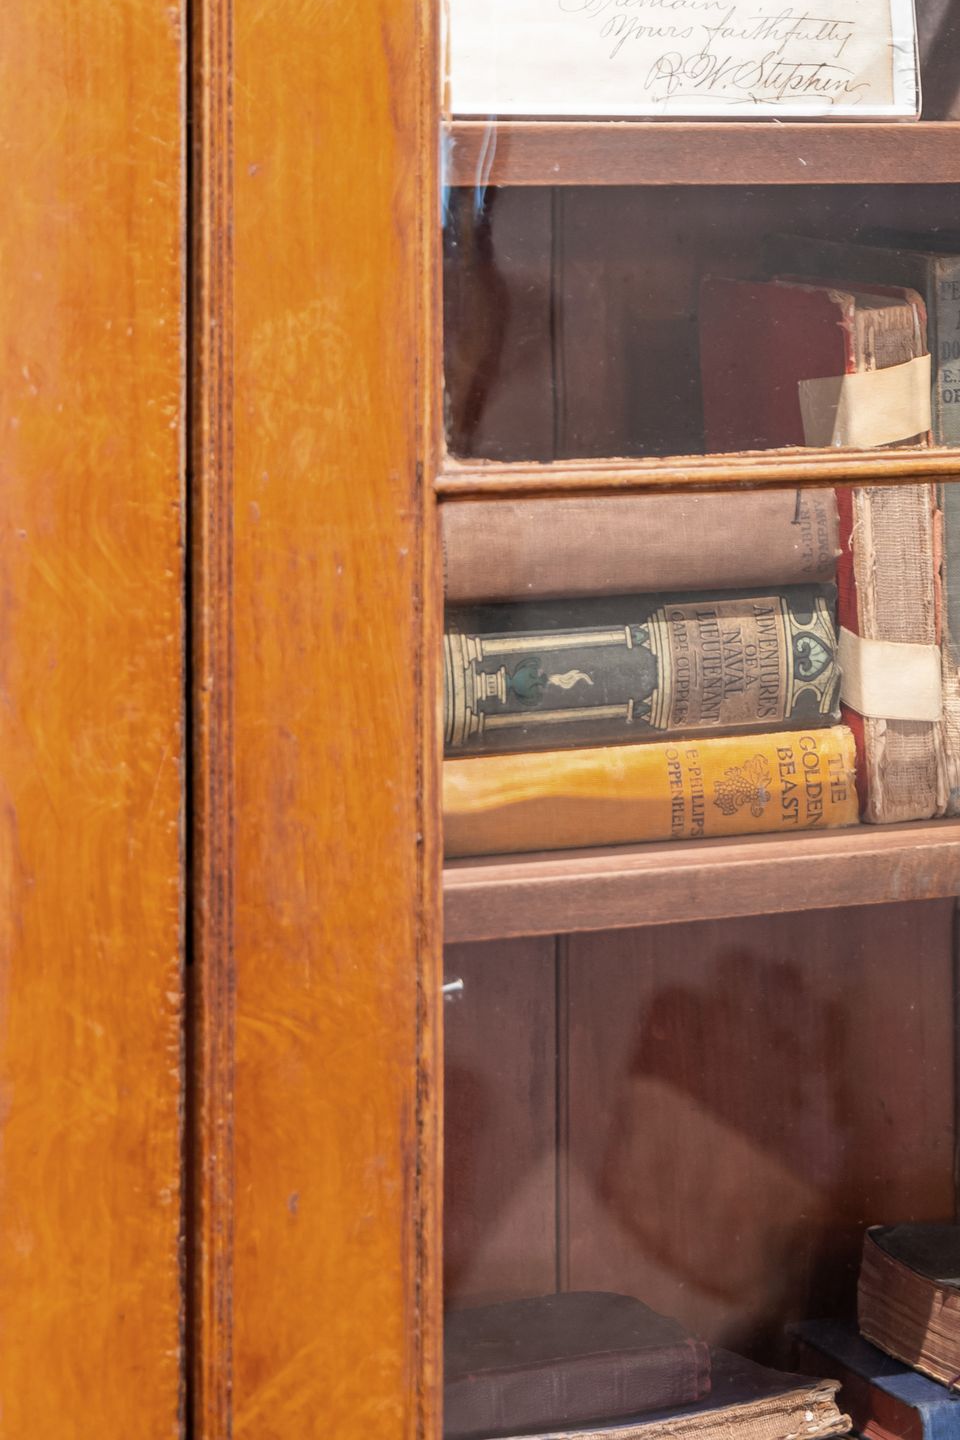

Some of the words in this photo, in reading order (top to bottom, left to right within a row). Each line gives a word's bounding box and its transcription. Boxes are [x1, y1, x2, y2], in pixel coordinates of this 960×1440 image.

[674, 656, 691, 726] CUPPLES
[695, 610, 721, 725] LIEUTENANT
[722, 628, 744, 700] NAVAL
[744, 644, 759, 668] OF
[745, 677, 760, 689] A
[752, 604, 780, 720] ADVENTURES
[776, 746, 799, 825] BEAST
[799, 735, 824, 826] GOLDEN
[828, 753, 848, 805] THE
